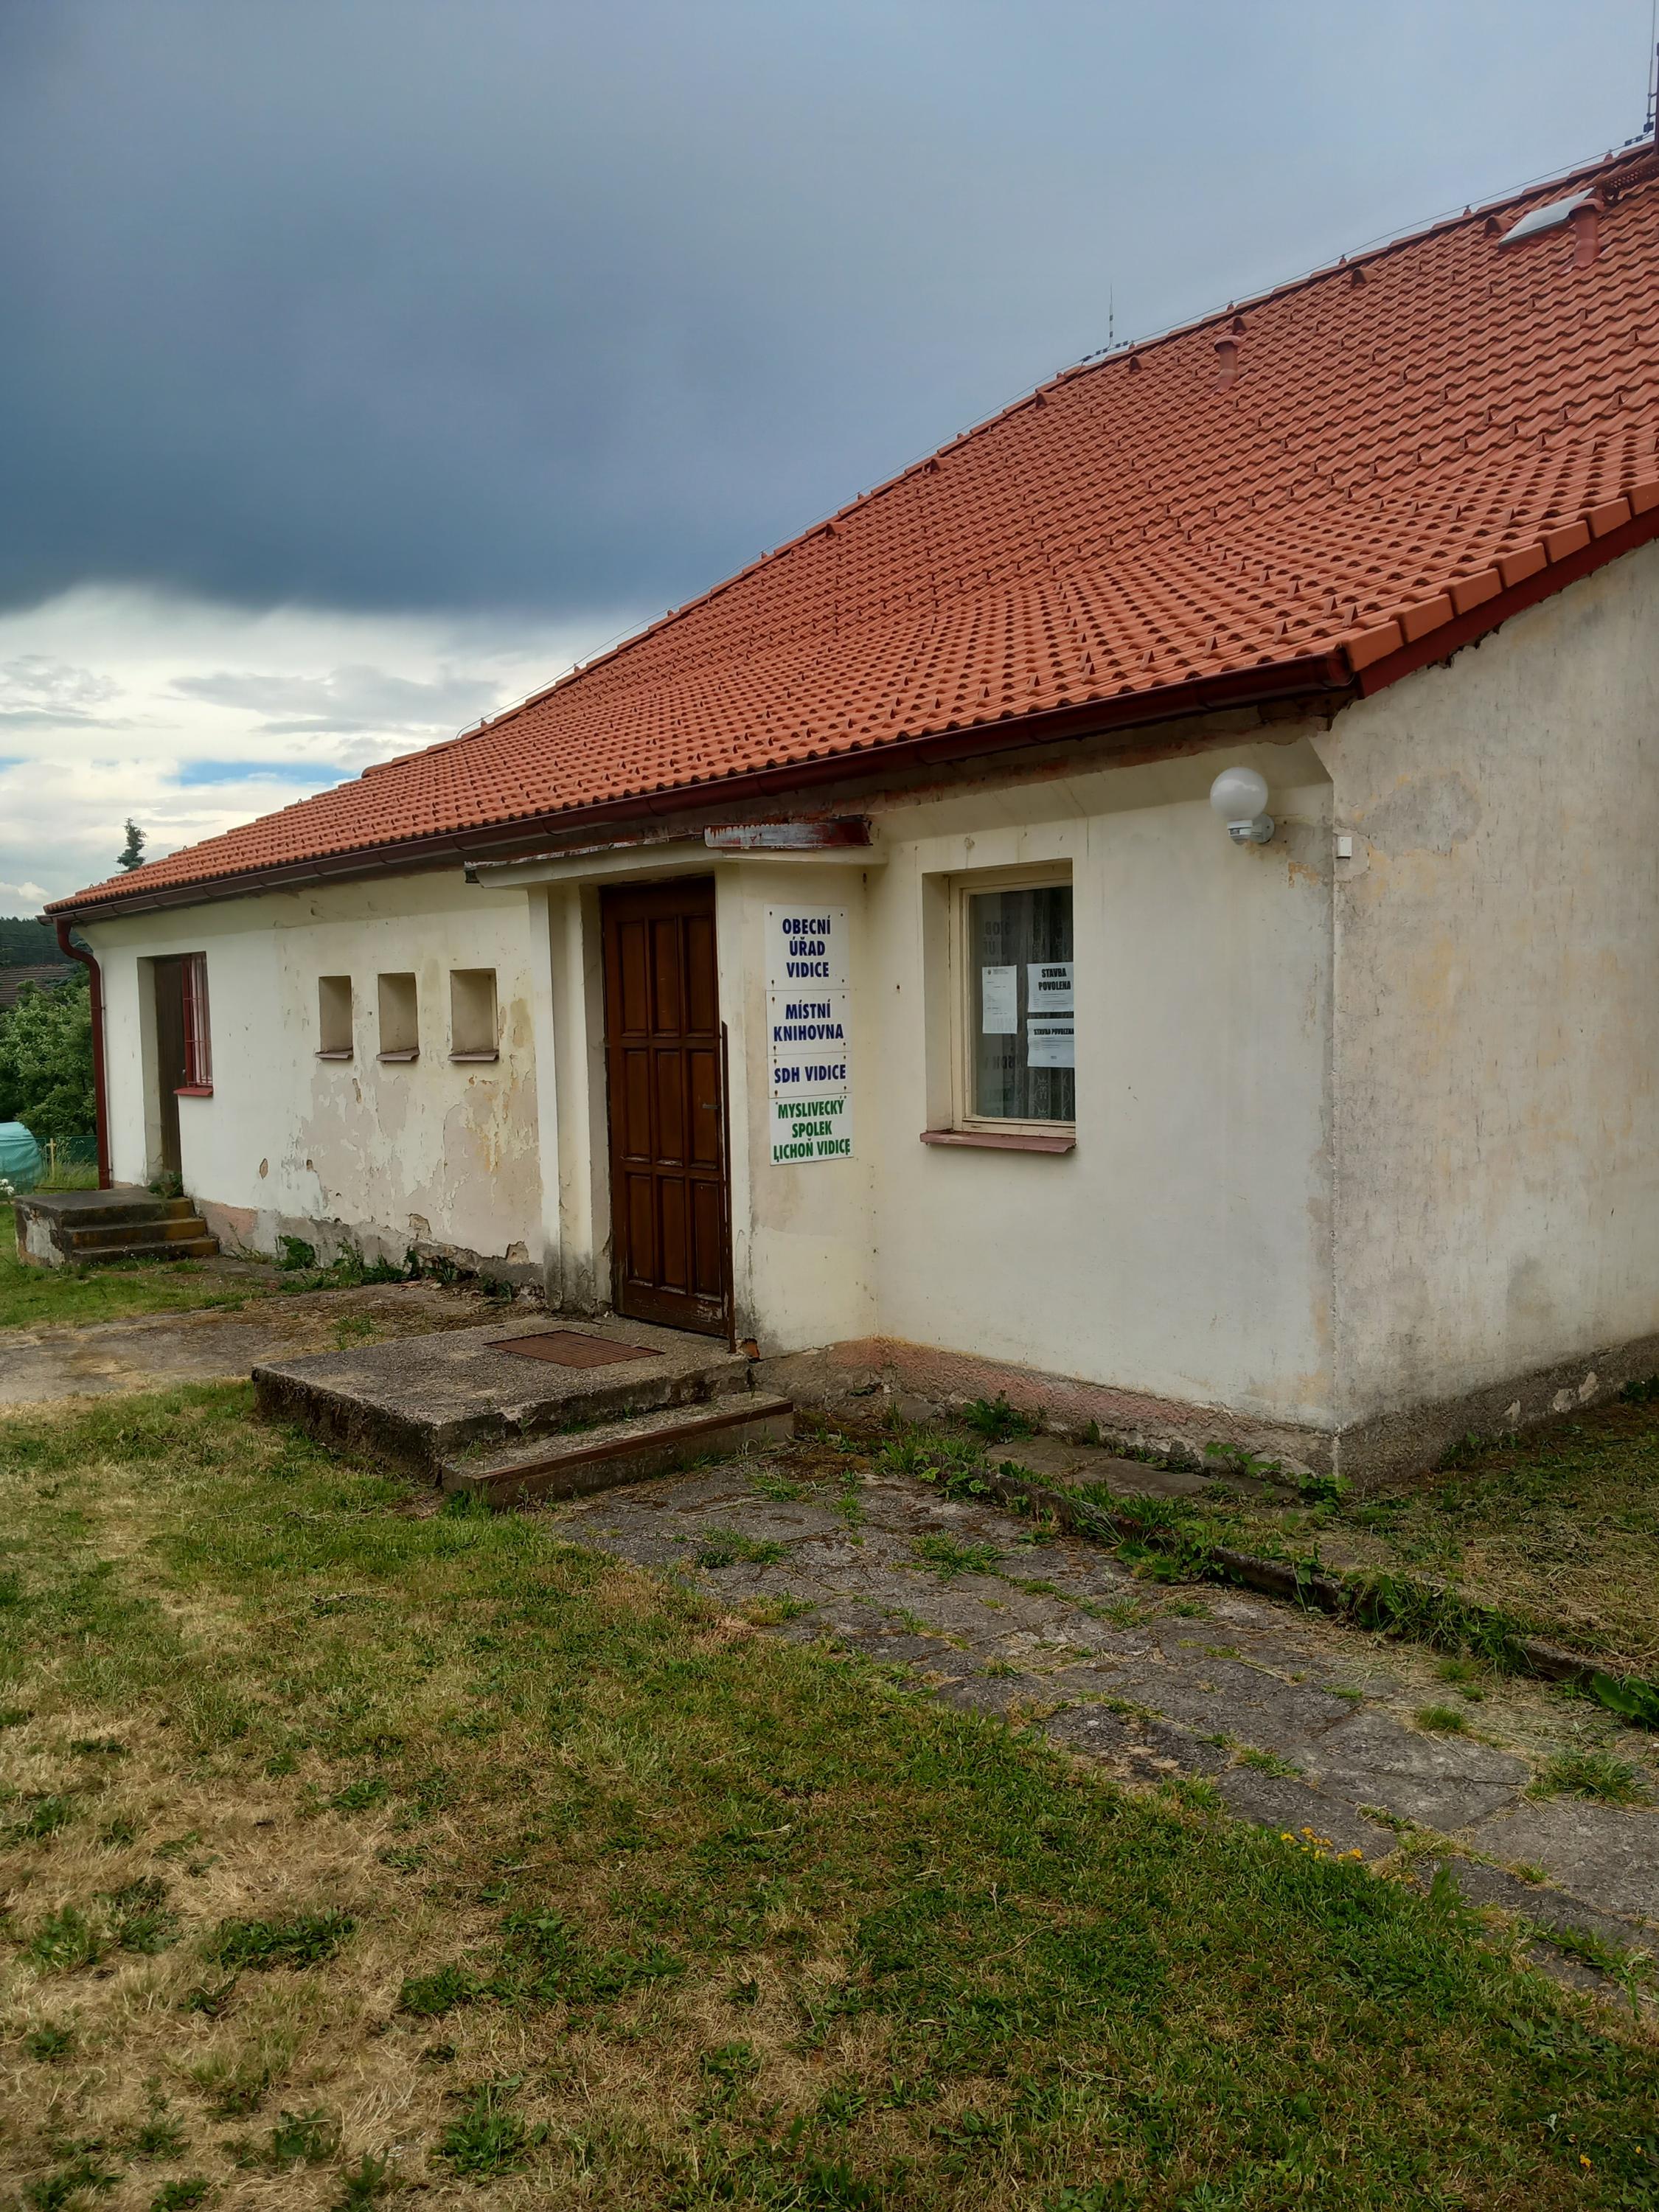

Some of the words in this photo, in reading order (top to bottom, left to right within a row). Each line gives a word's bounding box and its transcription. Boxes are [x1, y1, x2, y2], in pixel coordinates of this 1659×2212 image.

[782, 915, 831, 934] OBECNÍ
[790, 936, 825, 956] ÚŘAD
[786, 961, 829, 978] VIDICE
[1041, 968, 1067, 978] STAVBA
[1038, 981, 1071, 991] POVOLENA
[785, 999, 831, 1020] MÍSTNÍ
[774, 1023, 844, 1042] KNIHOVNA
[774, 1067, 800, 1083] SDH
[804, 1064, 846, 1082] VIDICE
[778, 1096, 844, 1119] MYSLIVECKÝ
[792, 1120, 832, 1138] SPOLEK
[773, 1138, 813, 1161] LICHOŇ
[815, 1138, 850, 1155] VIDICE
